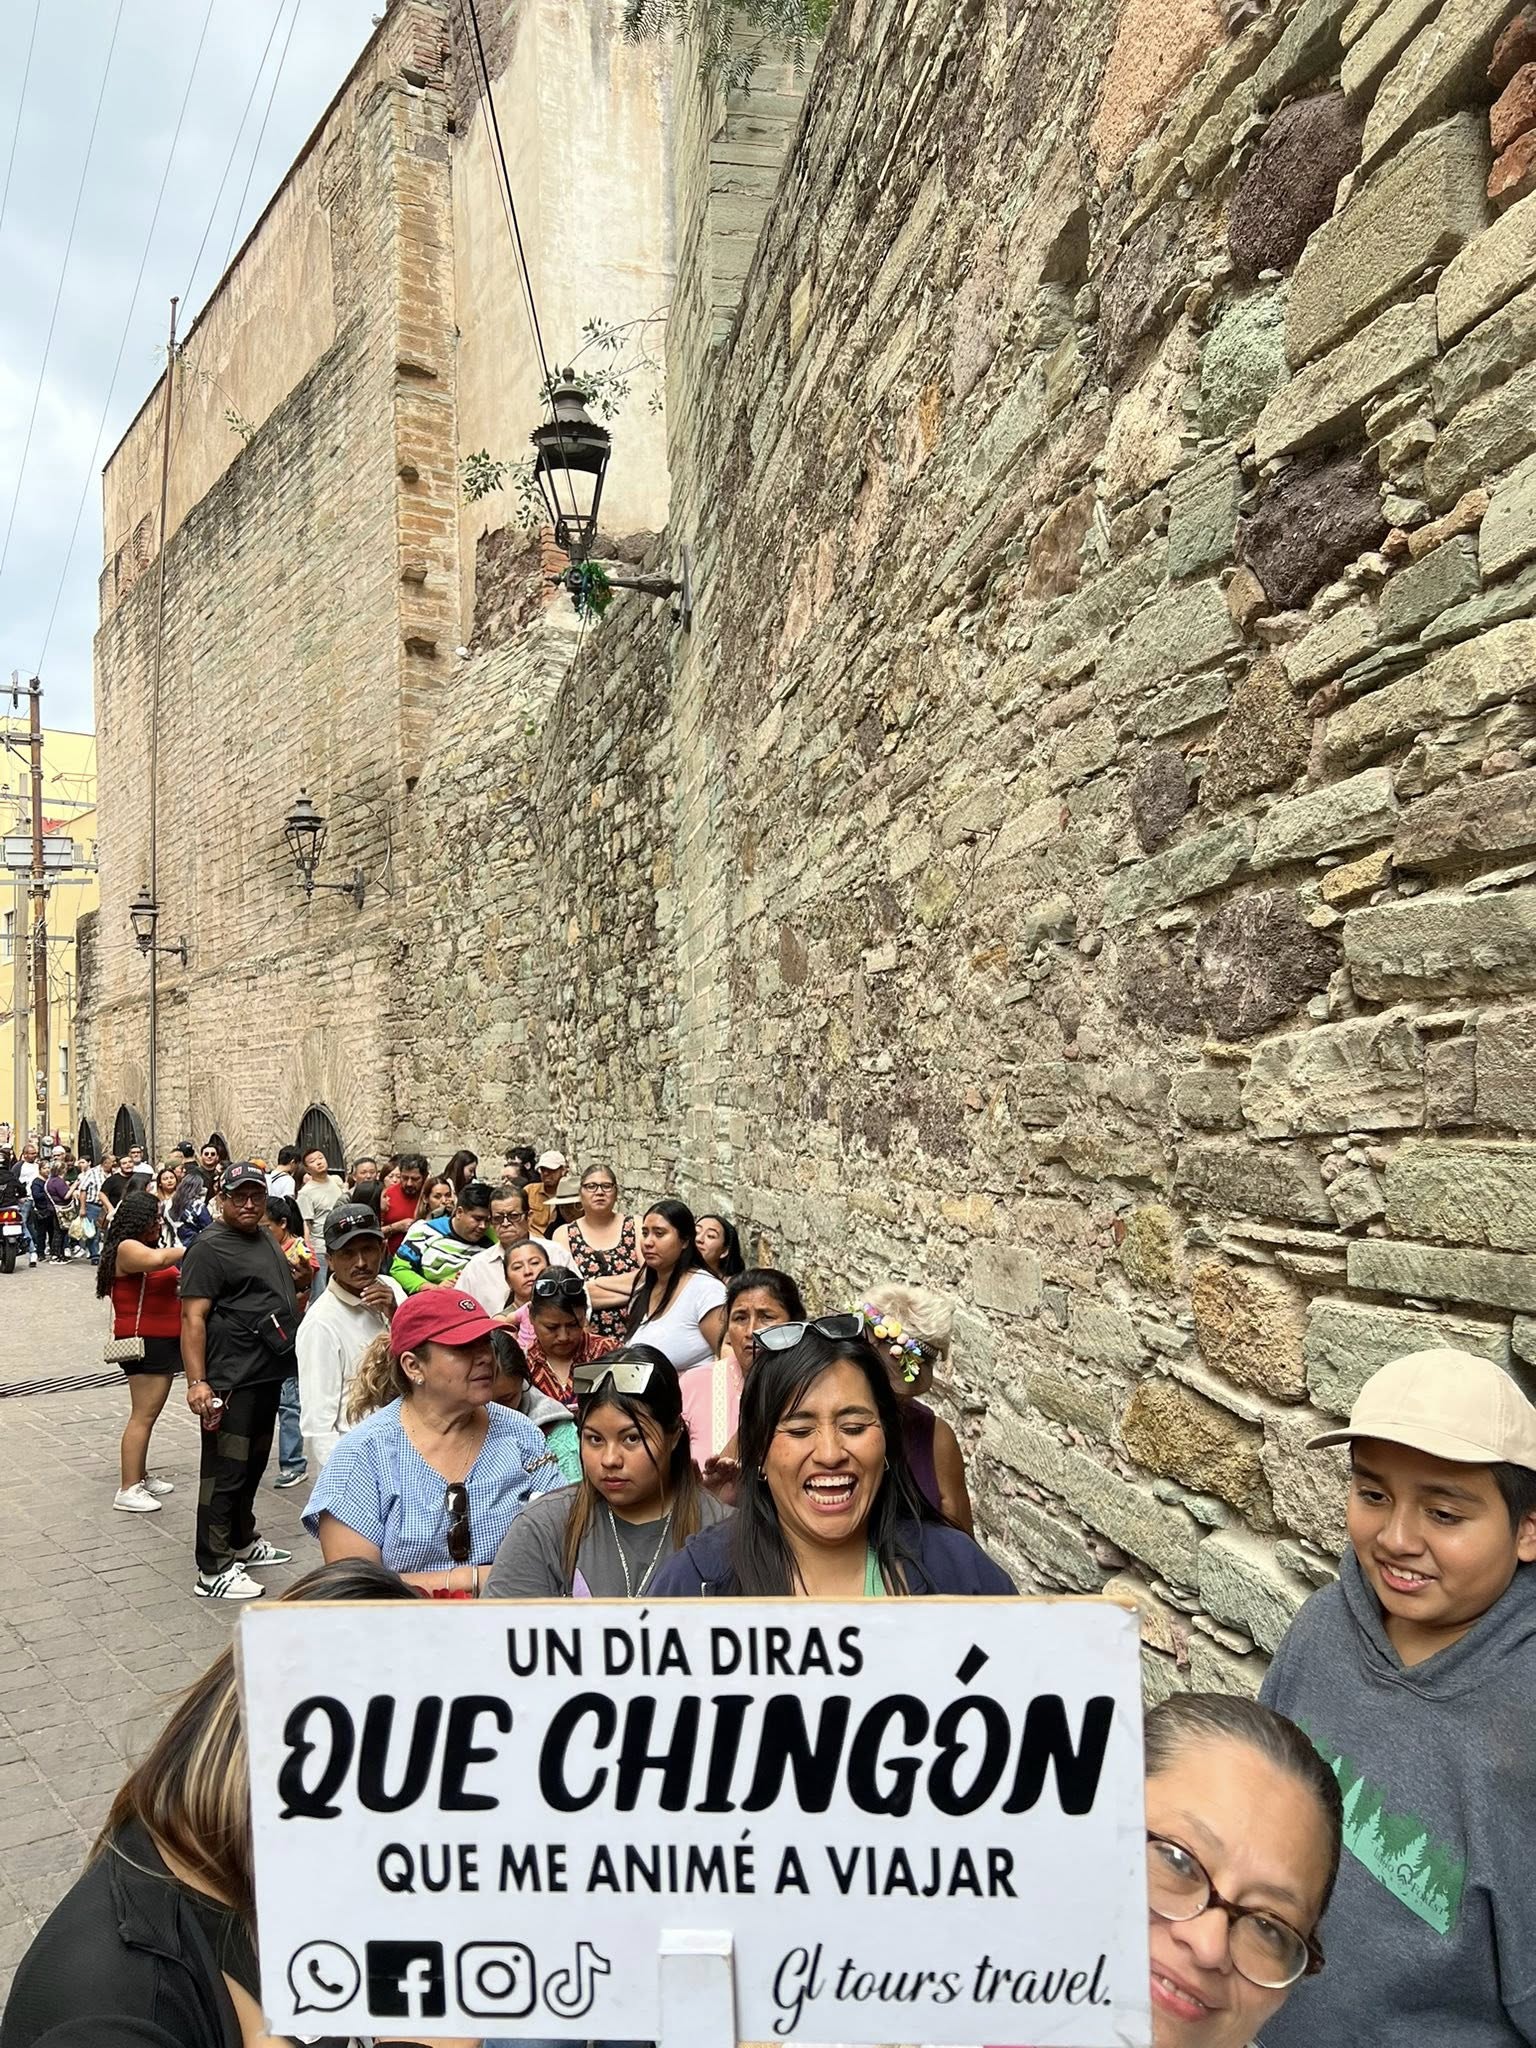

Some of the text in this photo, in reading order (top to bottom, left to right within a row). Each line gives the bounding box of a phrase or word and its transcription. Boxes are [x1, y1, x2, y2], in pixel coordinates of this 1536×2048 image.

[507, 1609, 865, 1677] UN DÍA DIRAS
[277, 1644, 1116, 1821] QUE CHINGÓN
[377, 1828, 1019, 1898] QUE ME ANIMÉ A VIAJAR
[834, 1957, 964, 2004] tours
[972, 1953, 1112, 2006] travel.
